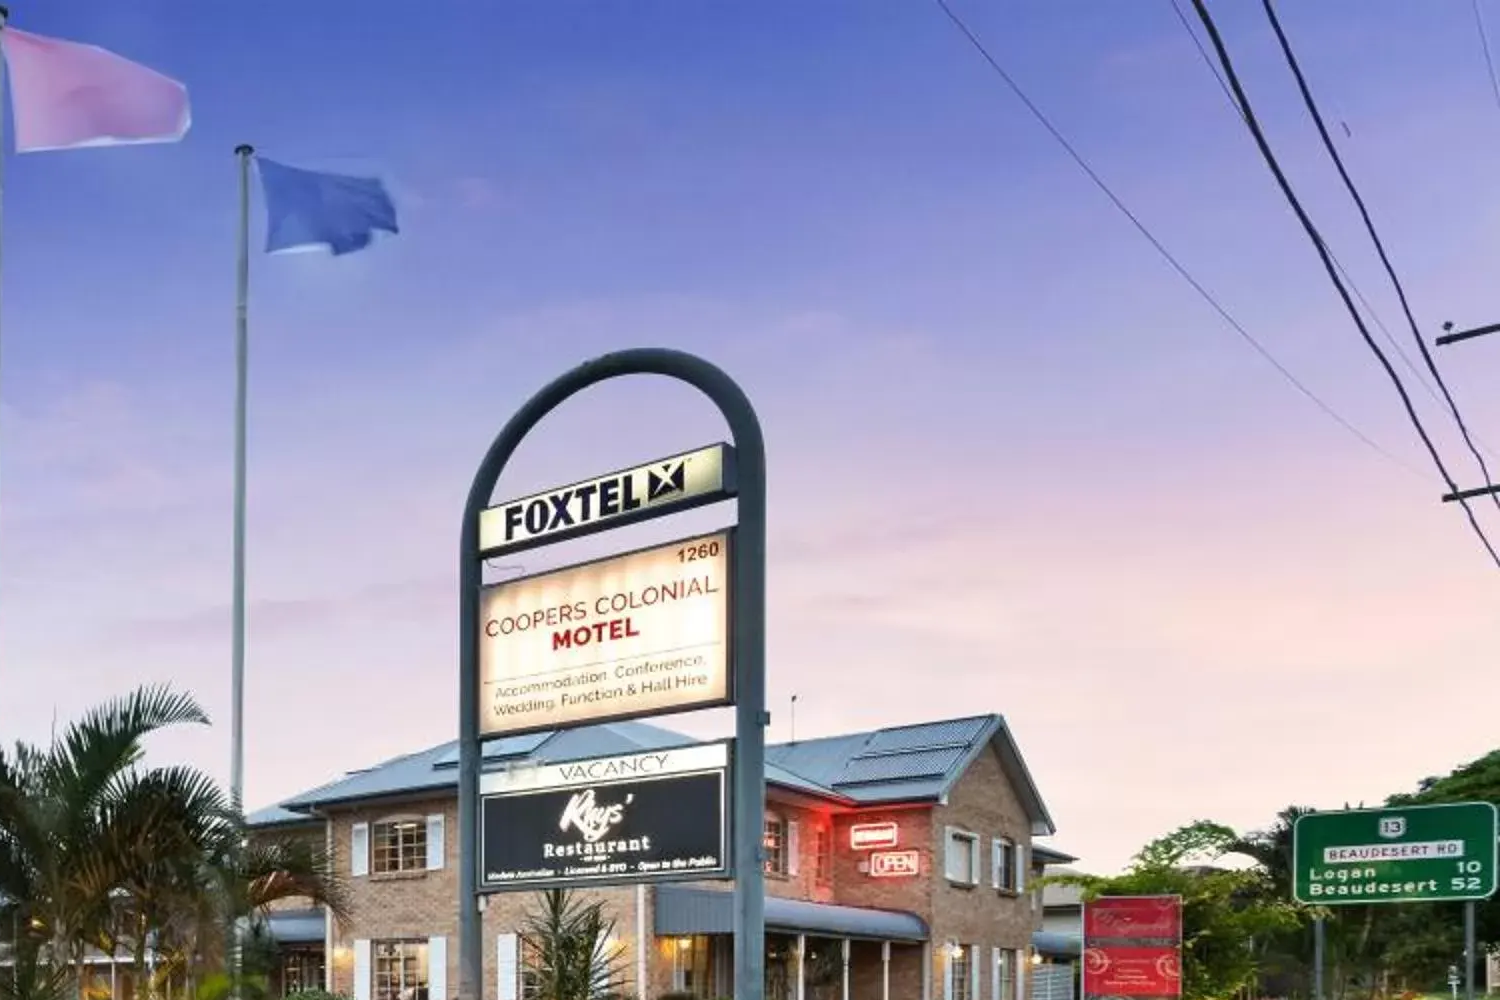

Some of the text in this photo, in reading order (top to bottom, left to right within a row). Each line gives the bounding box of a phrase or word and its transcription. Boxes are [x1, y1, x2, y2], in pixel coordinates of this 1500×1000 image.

[504, 474, 642, 541] FOXTEL
[678, 541, 720, 564] 1260
[485, 575, 720, 639] COOPERS COLONIAL
[552, 617, 640, 650] MOTEL
[561, 685, 623, 706] Function
[627, 684, 637, 696] &
[642, 676, 671, 693] Hall
[676, 672, 708, 688] Hire
[559, 754, 669, 781] VACANCY
[1384, 821, 1401, 834] 13
[543, 836, 651, 858] Restaurant
[1329, 842, 1457, 860] BEAUDESERT RD
[638, 861, 660, 872] Open
[672, 858, 687, 868] the
[875, 855, 916, 872] OPEN
[1309, 860, 1482, 882] Logan 10
[1309, 877, 1481, 895] Beaudesert 52
